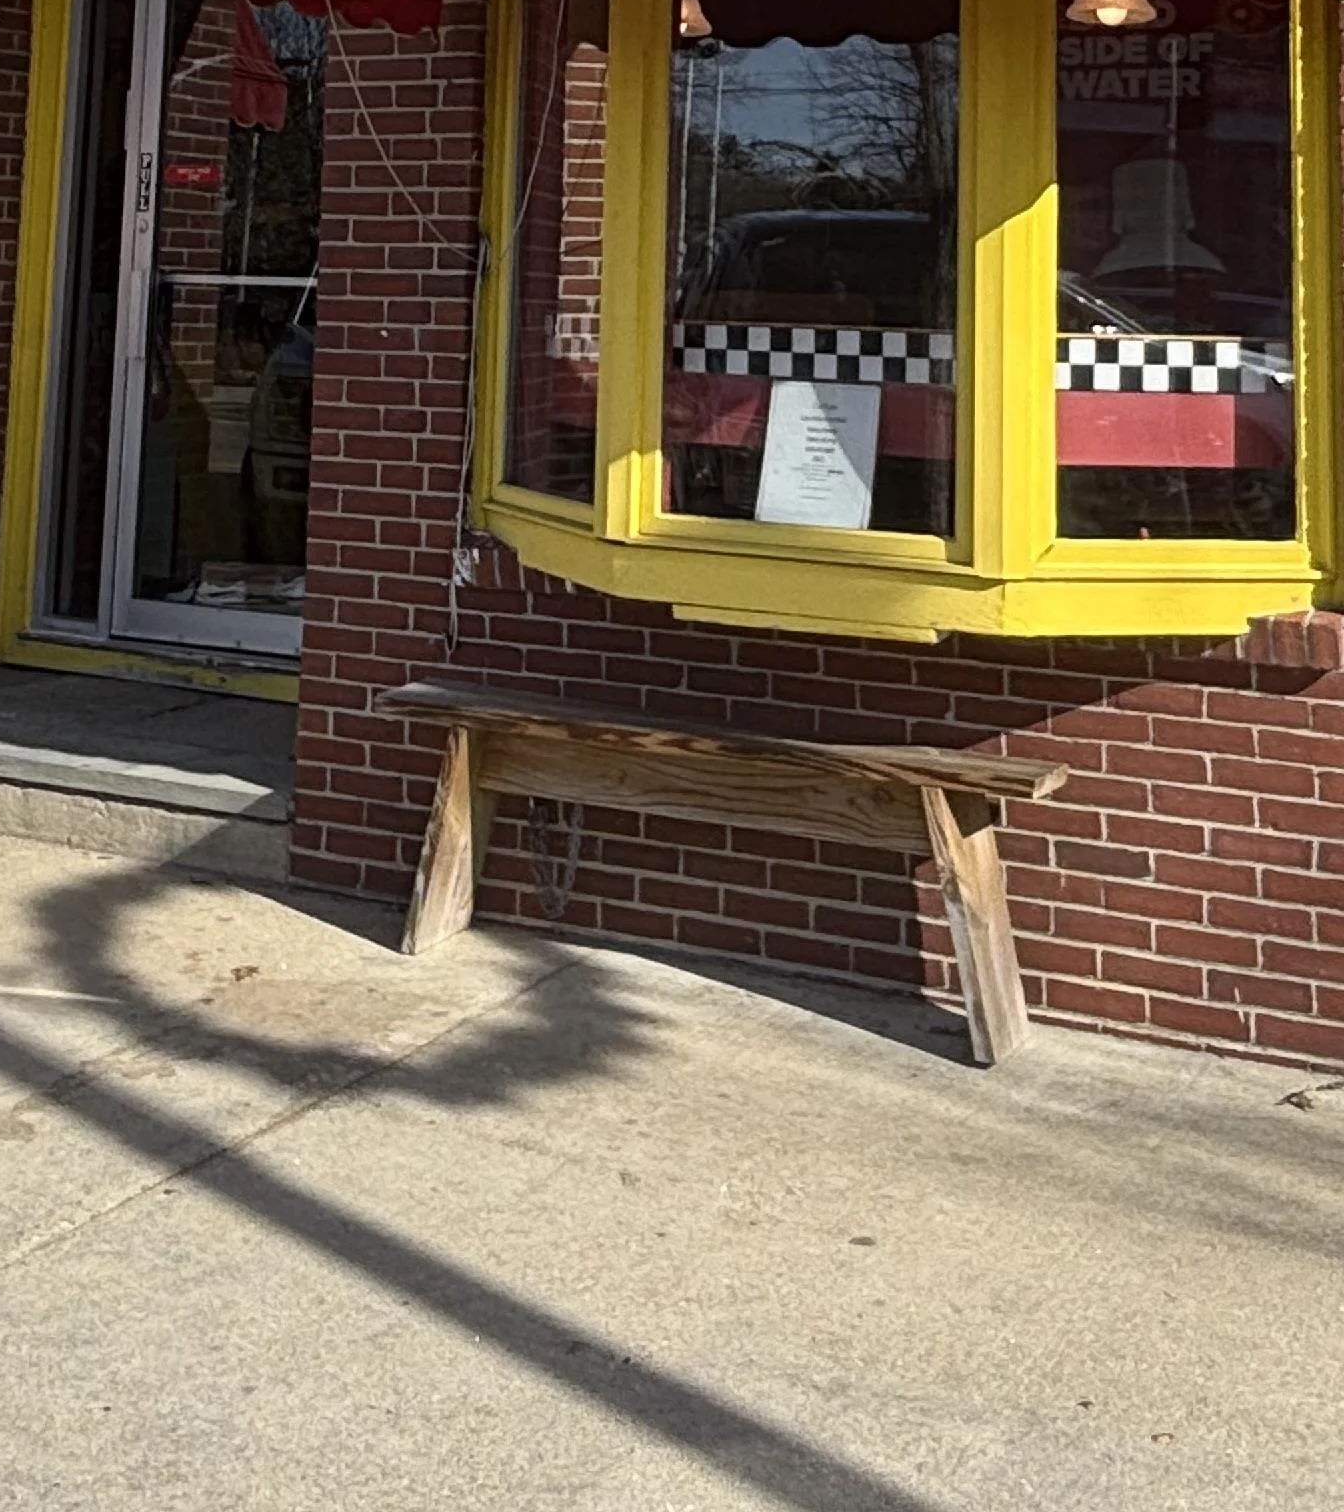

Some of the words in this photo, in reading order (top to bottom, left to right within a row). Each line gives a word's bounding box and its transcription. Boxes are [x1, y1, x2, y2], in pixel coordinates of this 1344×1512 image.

[1059, 34, 1149, 67] SIDE
[1158, 32, 1216, 65] OF
[1059, 68, 1202, 100] WATER
[139, 153, 153, 211] PULL
